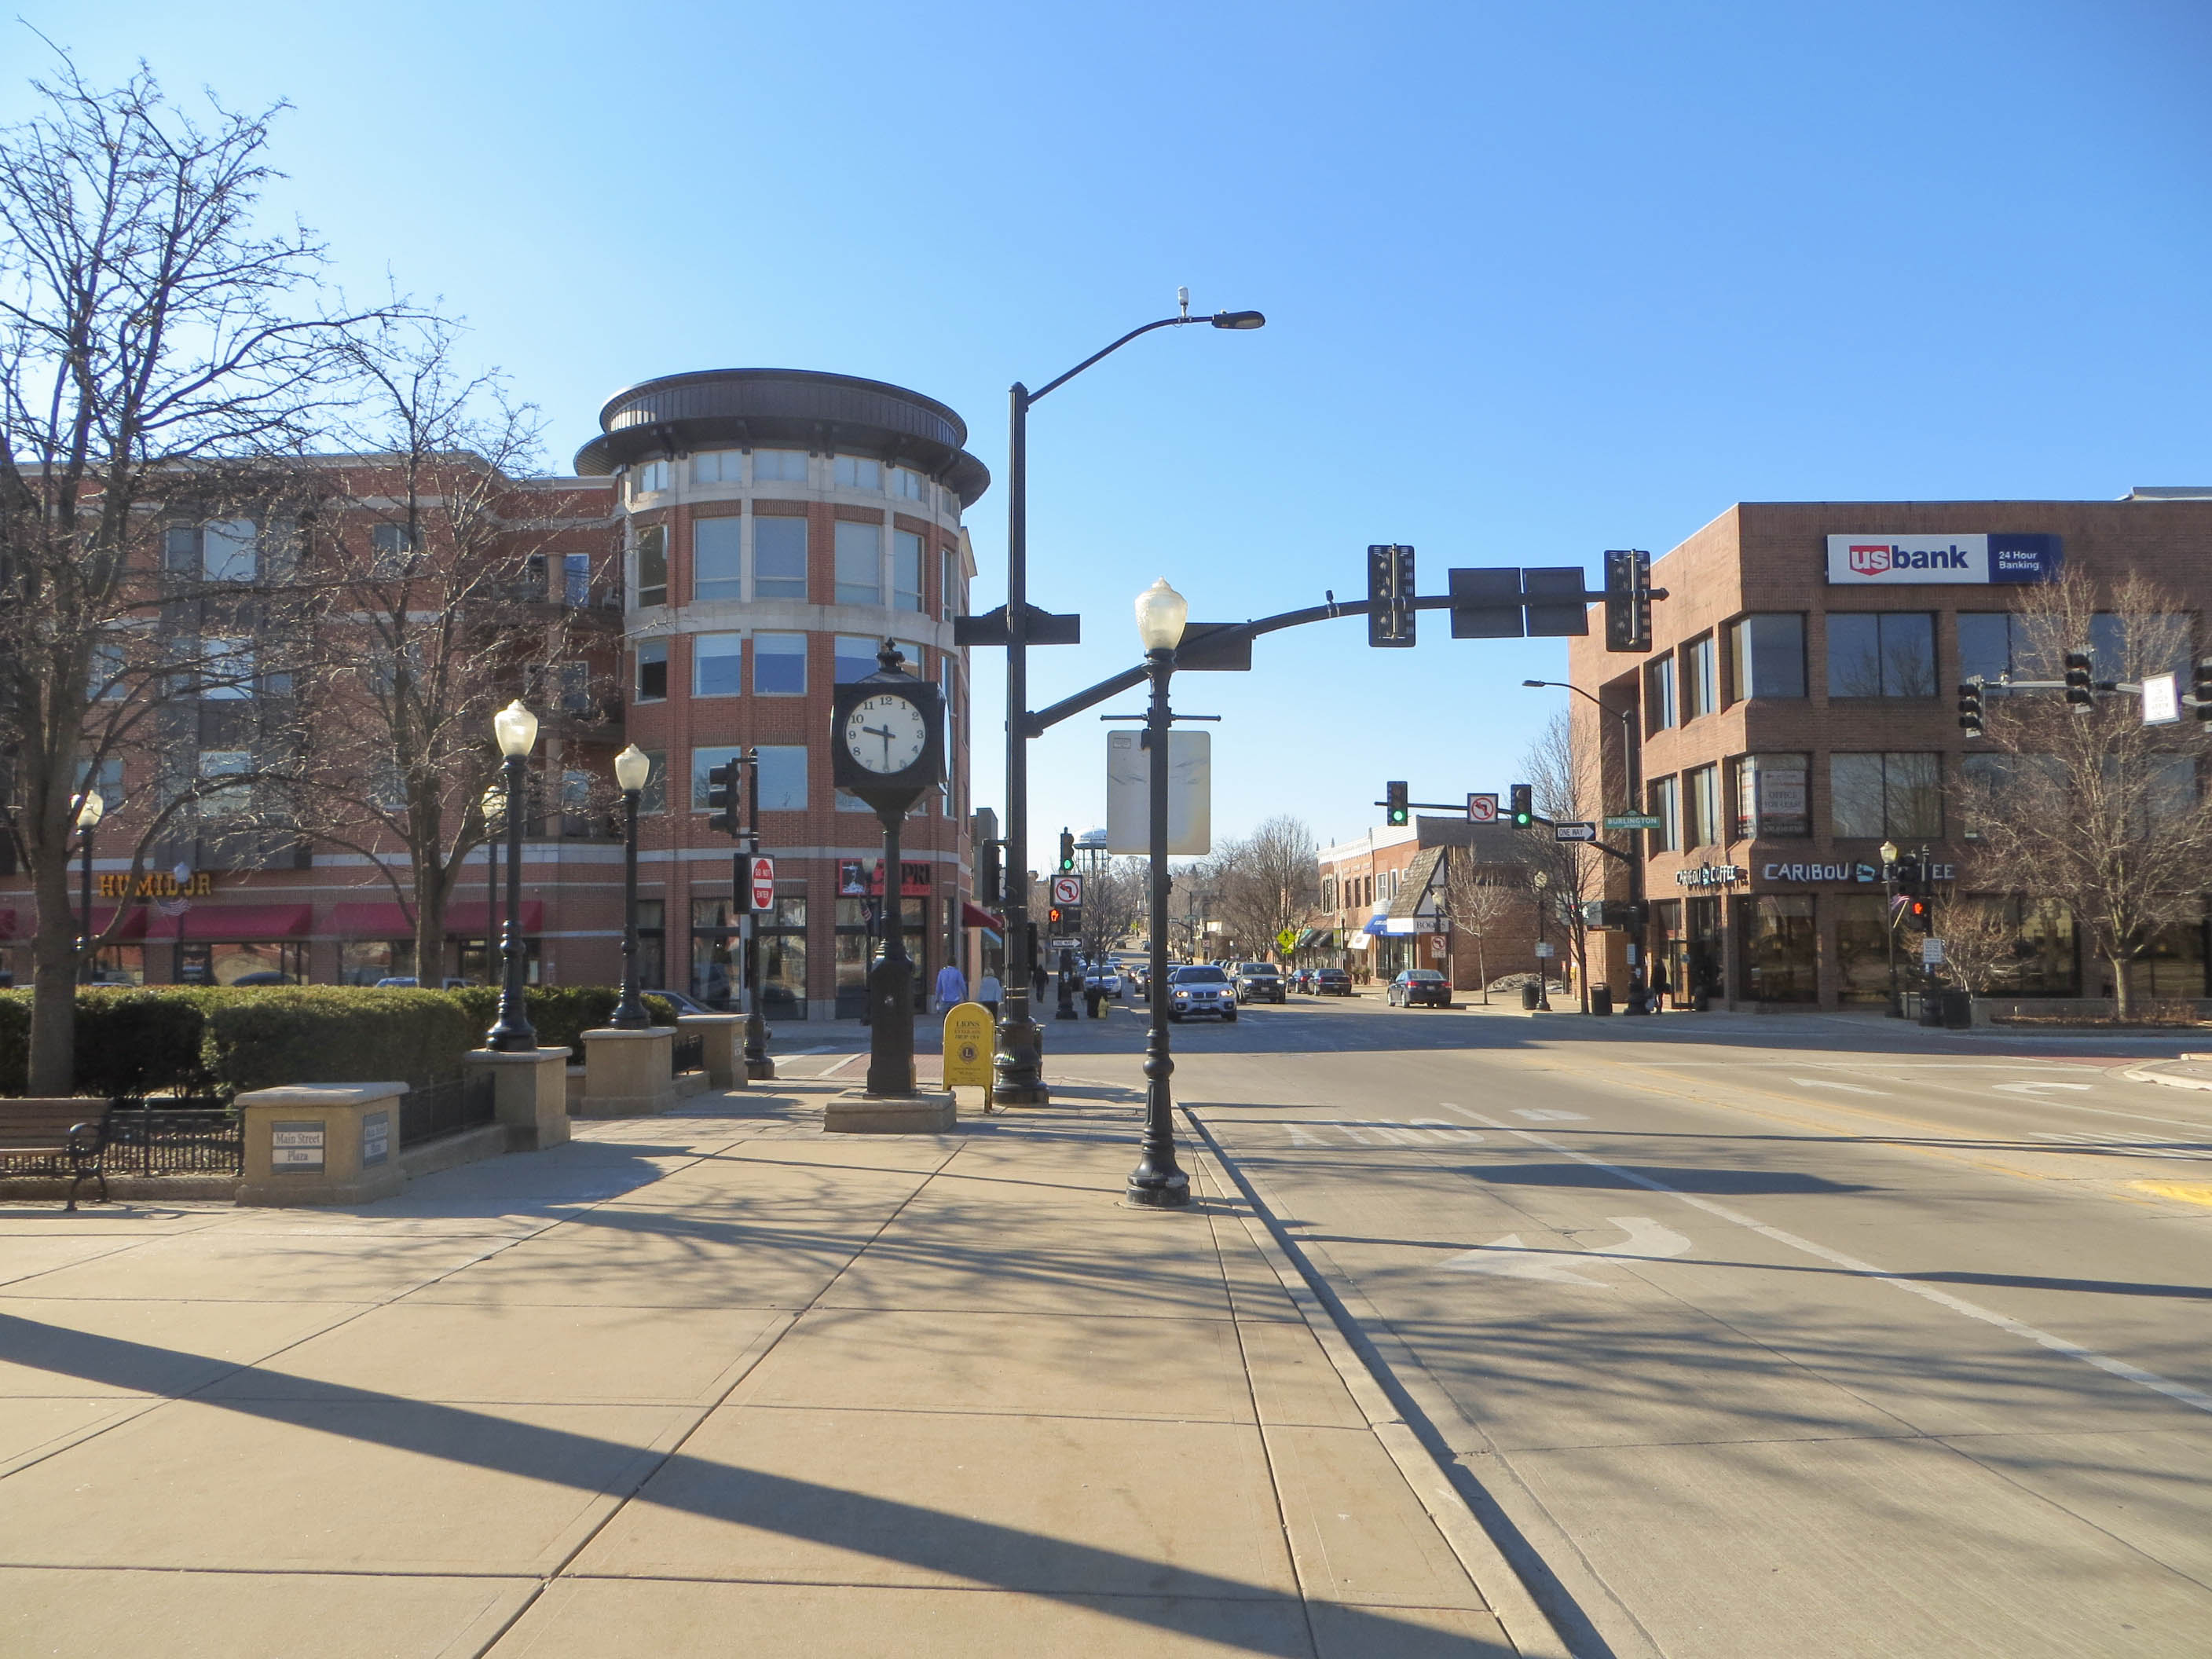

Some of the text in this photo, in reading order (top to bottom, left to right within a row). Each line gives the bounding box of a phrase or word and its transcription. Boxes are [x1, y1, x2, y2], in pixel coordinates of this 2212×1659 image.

[1998, 561, 2040, 571] Banking
[880, 696, 892, 705] 12
[864, 701, 874, 710] 11
[851, 714, 864, 723] 10
[912, 712, 919, 720] 2
[848, 731, 856, 739] 9
[917, 730, 924, 738] 3
[852, 747, 861, 756] 8
[911, 745, 918, 754] 4
[866, 760, 873, 768] 7
[756, 868, 771, 877] DO NOT
[1764, 862, 1848, 882] CARIBOU
[276, 1133, 320, 1144] Main Street
[287, 1150, 308, 1161] Plaza
